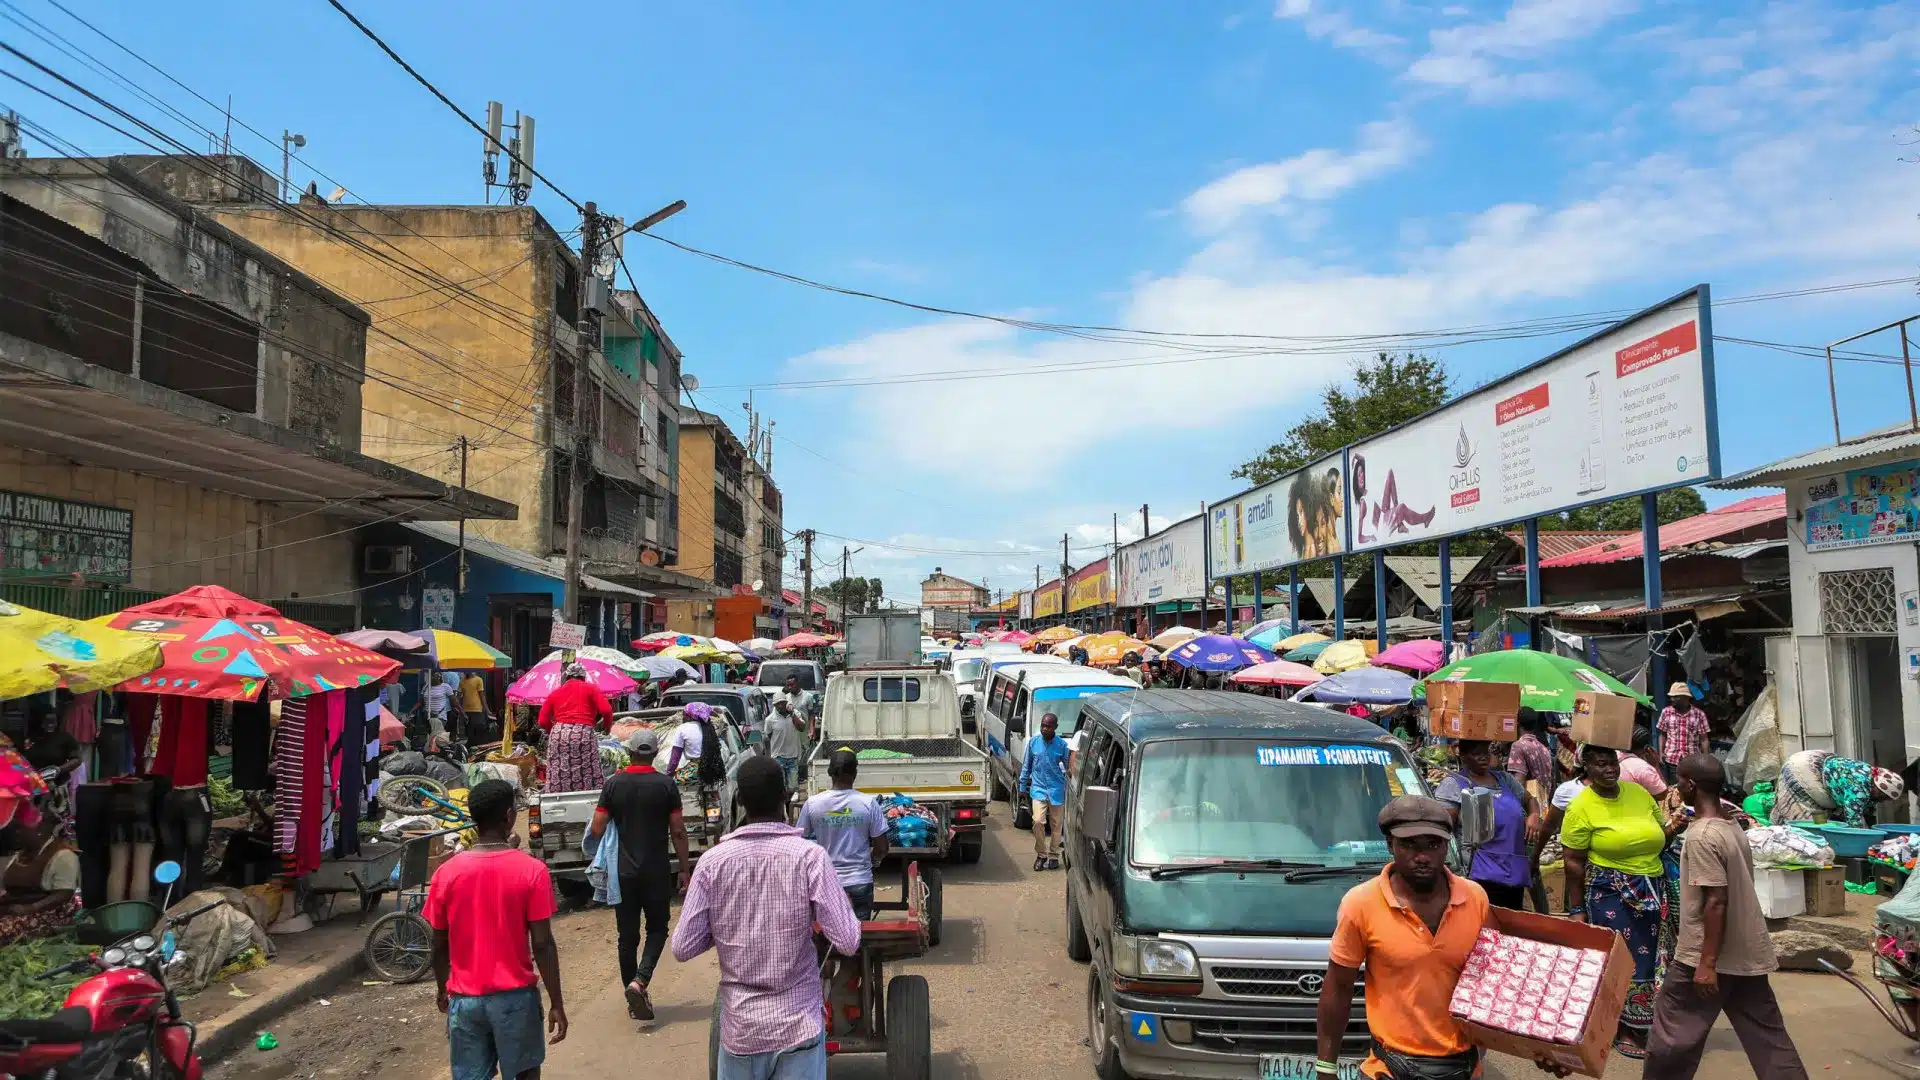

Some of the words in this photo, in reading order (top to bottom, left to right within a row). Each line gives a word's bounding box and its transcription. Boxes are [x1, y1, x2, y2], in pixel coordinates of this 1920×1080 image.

[1622, 352, 1661, 374] Comprovado
[1662, 346, 1680, 358] Para:
[1623, 384, 1651, 399] Minimizar
[1624, 400, 1644, 412] Reduzir
[1624, 410, 1653, 424] Aumentar
[1660, 402, 1678, 414] brilho
[1625, 425, 1648, 438] Hidratar
[1654, 418, 1668, 432] pele
[1626, 439, 1648, 452] Unificar
[1654, 434, 1666, 443] tom
[1668, 430, 1676, 440] de
[1678, 425, 1692, 440] pele
[1626, 453, 1645, 464] DeTox
[63, 504, 131, 532] XIPAMANINE
[1248, 494, 1273, 524] amalfi
[1259, 748, 1320, 765] XIPAMANINE
